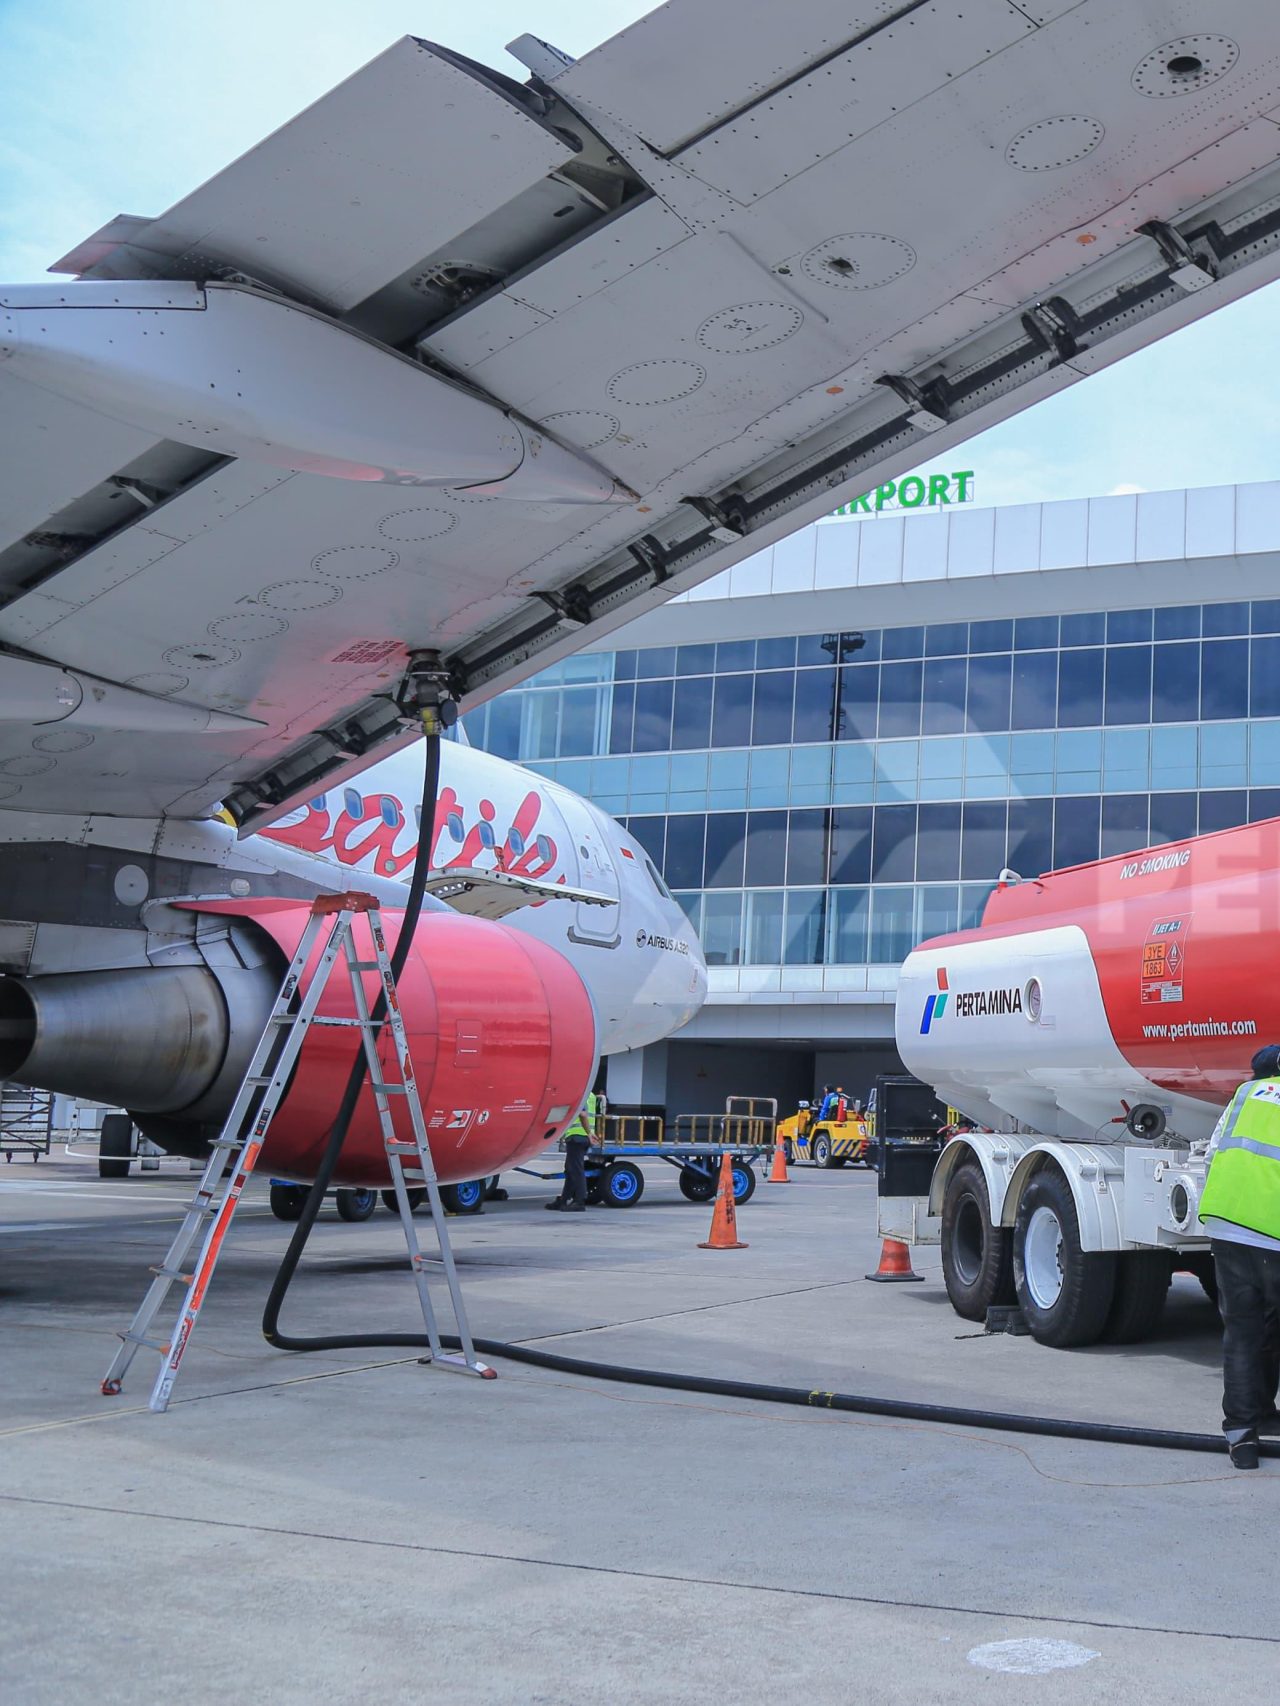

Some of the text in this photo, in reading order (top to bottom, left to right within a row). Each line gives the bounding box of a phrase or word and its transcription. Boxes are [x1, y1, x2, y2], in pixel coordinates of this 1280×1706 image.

[827, 470, 974, 516] RPORT
[1120, 849, 1191, 880] NO SMOKING
[647, 934, 689, 955] AIRBUS A320
[1148, 945, 1163, 959] 3YE
[1145, 961, 1163, 976] 1863
[956, 988, 1022, 1017] PERTAMINA
[1142, 1016, 1257, 1042] www.pertamina.com
